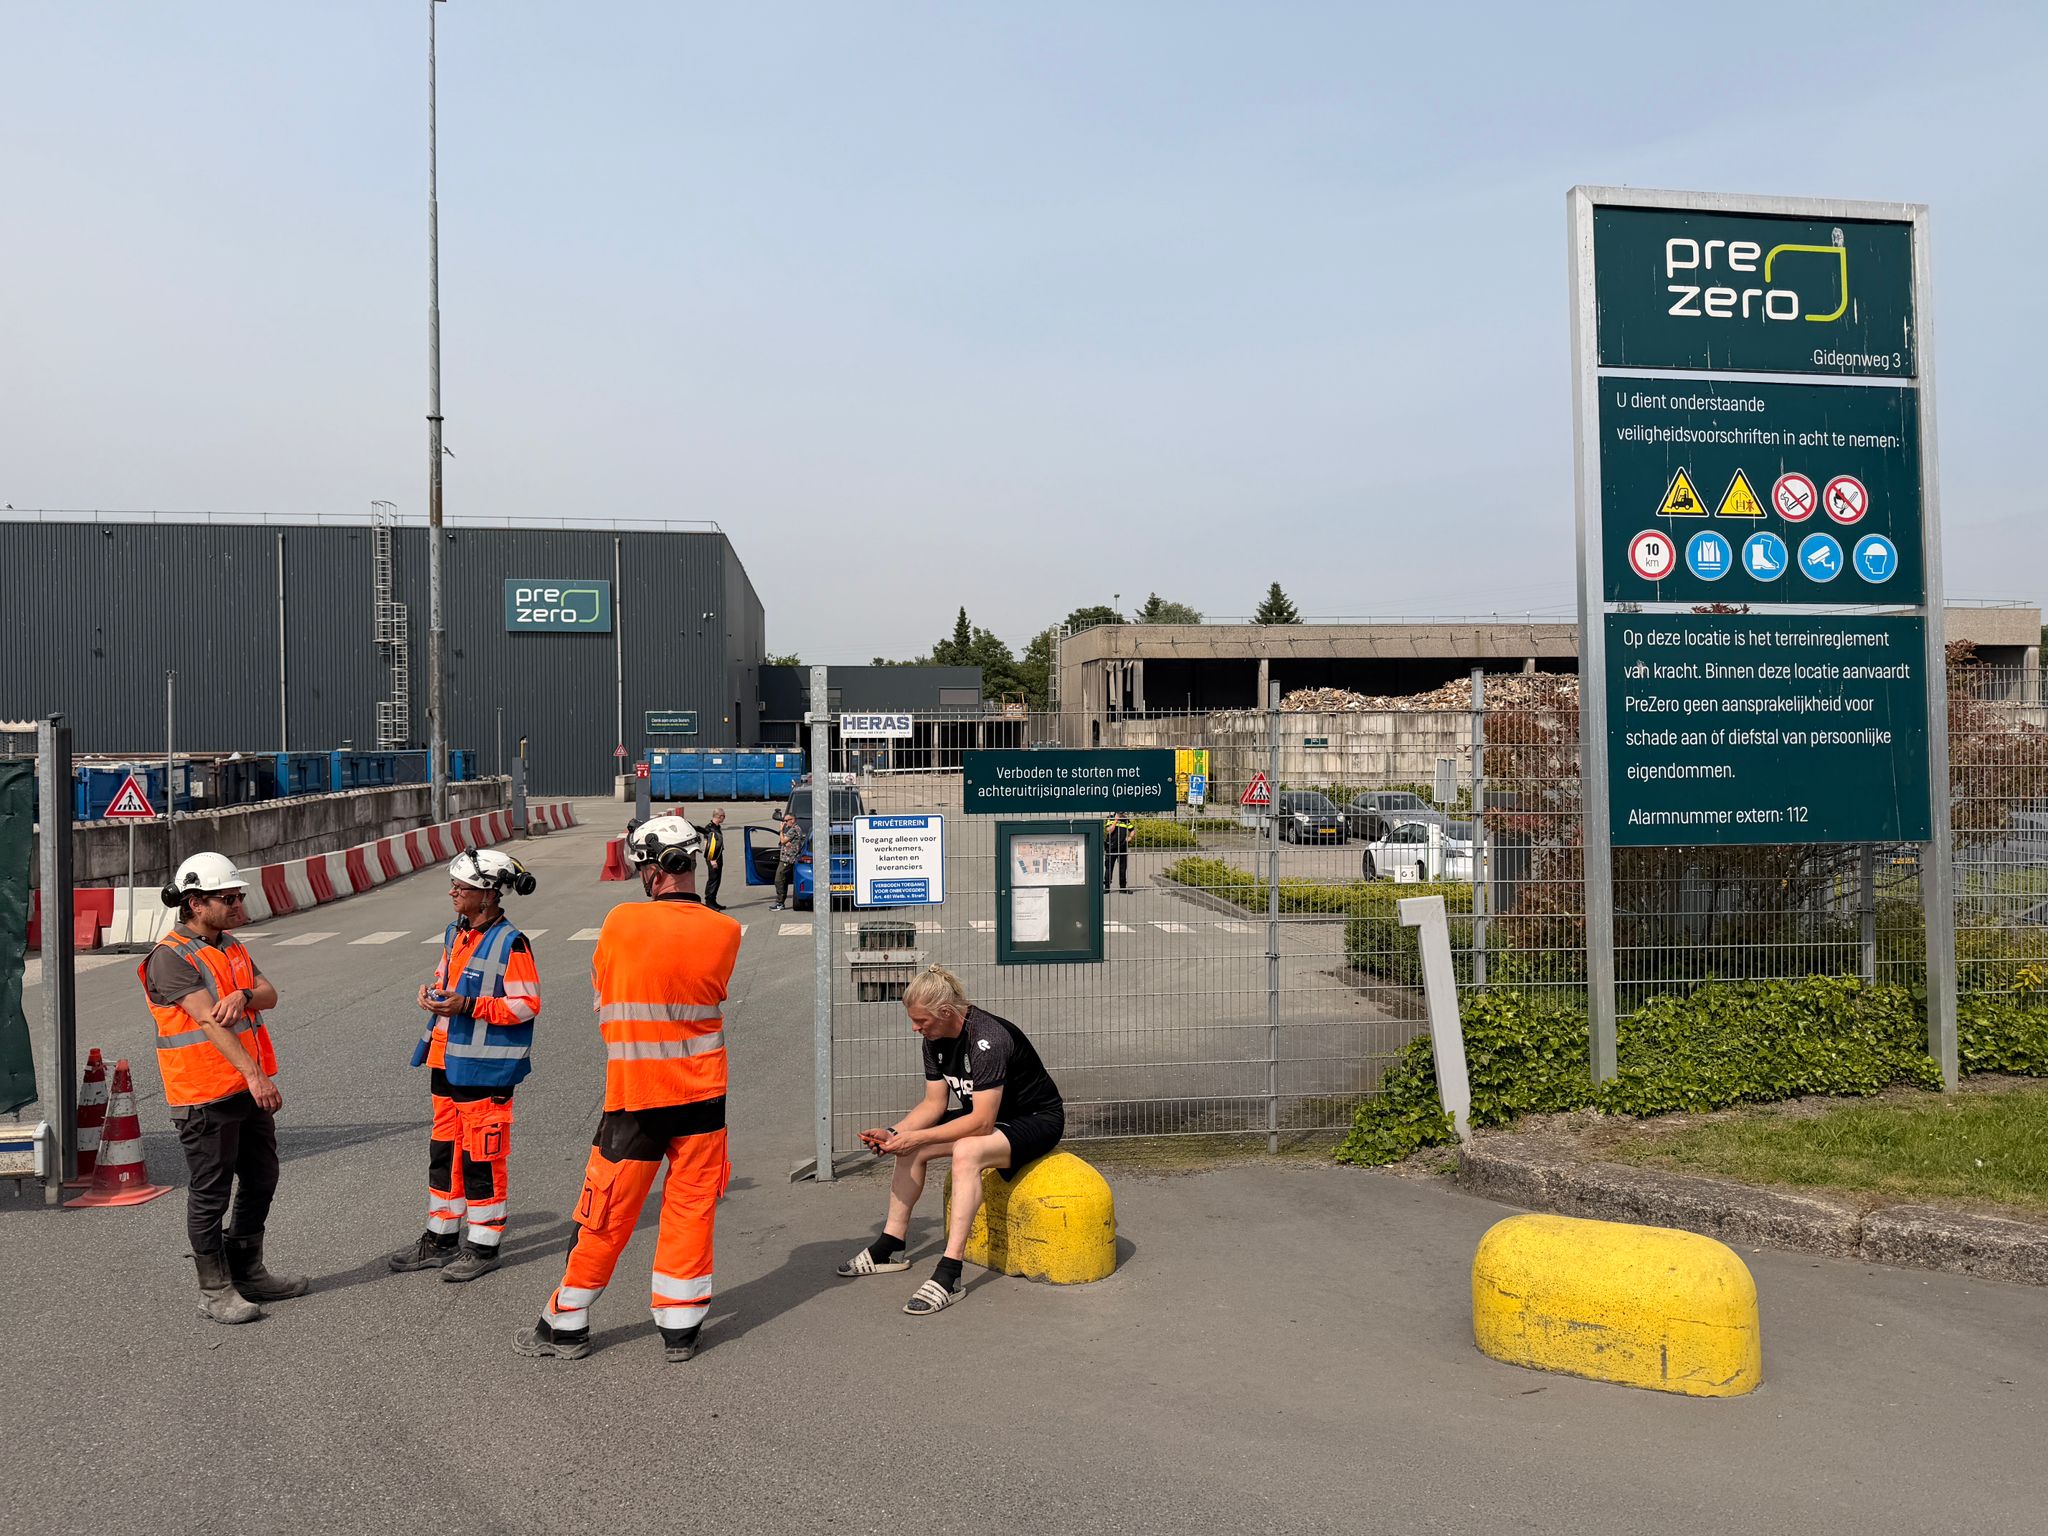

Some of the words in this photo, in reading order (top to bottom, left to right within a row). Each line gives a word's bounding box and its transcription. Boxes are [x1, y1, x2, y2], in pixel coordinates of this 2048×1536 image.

[1666, 238, 1761, 278] pre
[1668, 285, 1799, 320] zero
[1813, 350, 1890, 370] Gideonweg
[1893, 353, 1901, 367] 3
[1616, 392, 1627, 408] U
[1631, 392, 1667, 410] dient
[1670, 394, 1765, 412] onderstaande
[1617, 426, 1780, 445] veiligheidsvoorschriften
[1783, 430, 1796, 446] in
[1799, 431, 1829, 447] acht
[1832, 432, 1846, 447] te
[1849, 435, 1900, 448] nemen:
[1645, 543, 1660, 556] 10
[1645, 557, 1660, 568] km
[516, 588, 560, 606] pre
[516, 608, 577, 623] zero
[1623, 630, 1643, 648] Op
[1647, 630, 1681, 647] deze
[1684, 629, 1731, 647] locatie
[1734, 630, 1746, 646] is
[1749, 630, 1772, 647] het
[1775, 631, 1890, 650] terreinreglement
[1624, 665, 1650, 680] van
[1653, 663, 1702, 680] kracht.
[1705, 663, 1754, 680] Binnen
[1758, 663, 1791, 680] deze
[1794, 663, 1840, 680] locatie
[1842, 662, 1911, 680] aanvaardt
[1625, 697, 1680, 713] PreZero
[1683, 699, 1719, 716] geen
[1721, 695, 1842, 716] aansprakelijkheid
[1844, 698, 1874, 712] voor
[842, 716, 910, 730] HERAS
[1626, 729, 1678, 746] schade
[1681, 731, 1708, 746] aan
[1711, 729, 1726, 745] of
[1728, 728, 1779, 745] diefstal
[1782, 731, 1808, 745] van
[1811, 728, 1892, 748] persoonlijke
[996, 766, 1054, 779] Verboden
[1056, 768, 1069, 779] te
[1072, 767, 1114, 779] storten
[1116, 767, 1141, 779] met
[1627, 763, 1736, 783] eigendommen.
[978, 783, 1109, 798] achteruitrijsignalering
[1112, 783, 1162, 797] (piepjes)
[1628, 808, 1733, 826] Alarmnummer
[1735, 808, 1784, 824] extern:
[1786, 806, 1809, 823] 112
[861, 836, 893, 845] Toegang
